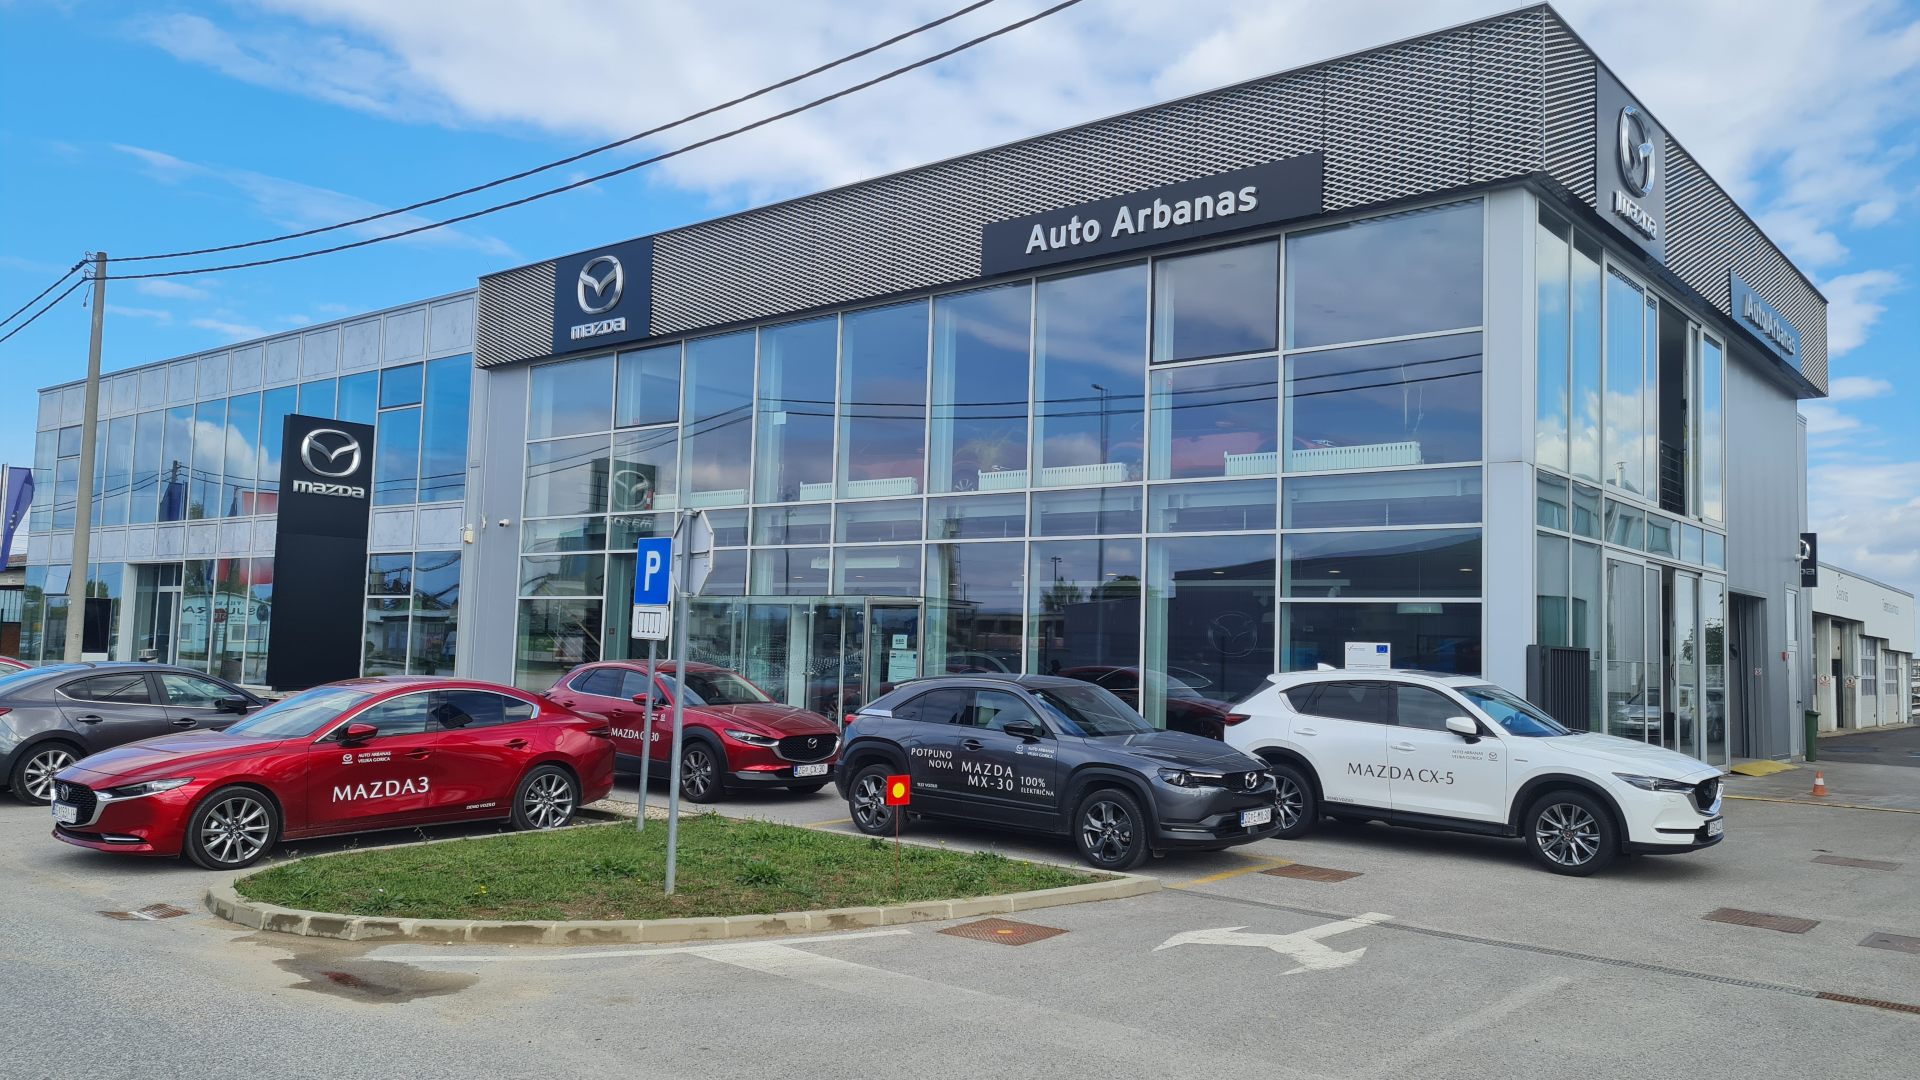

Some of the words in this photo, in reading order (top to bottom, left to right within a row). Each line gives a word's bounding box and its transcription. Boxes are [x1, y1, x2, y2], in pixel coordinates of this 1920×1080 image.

[1025, 215, 1101, 254] Auto
[1111, 186, 1259, 238] Arbanas
[1744, 293, 1767, 332] Auto
[1767, 312, 1796, 355] Arbanas
[644, 550, 661, 592] P
[611, 727, 639, 742] MAZDA
[910, 747, 953, 759] POTPUNO
[928, 759, 953, 770] NOVA
[961, 761, 1013, 778] MAZDA
[1020, 776, 1046, 788] 100%
[1347, 762, 1415, 782] MAZDA
[1418, 769, 1454, 785] CX-5
[332, 776, 430, 802] MAZDA3
[967, 774, 1014, 791] MX-30
[1020, 786, 1055, 797] ELEKTRIČNA
